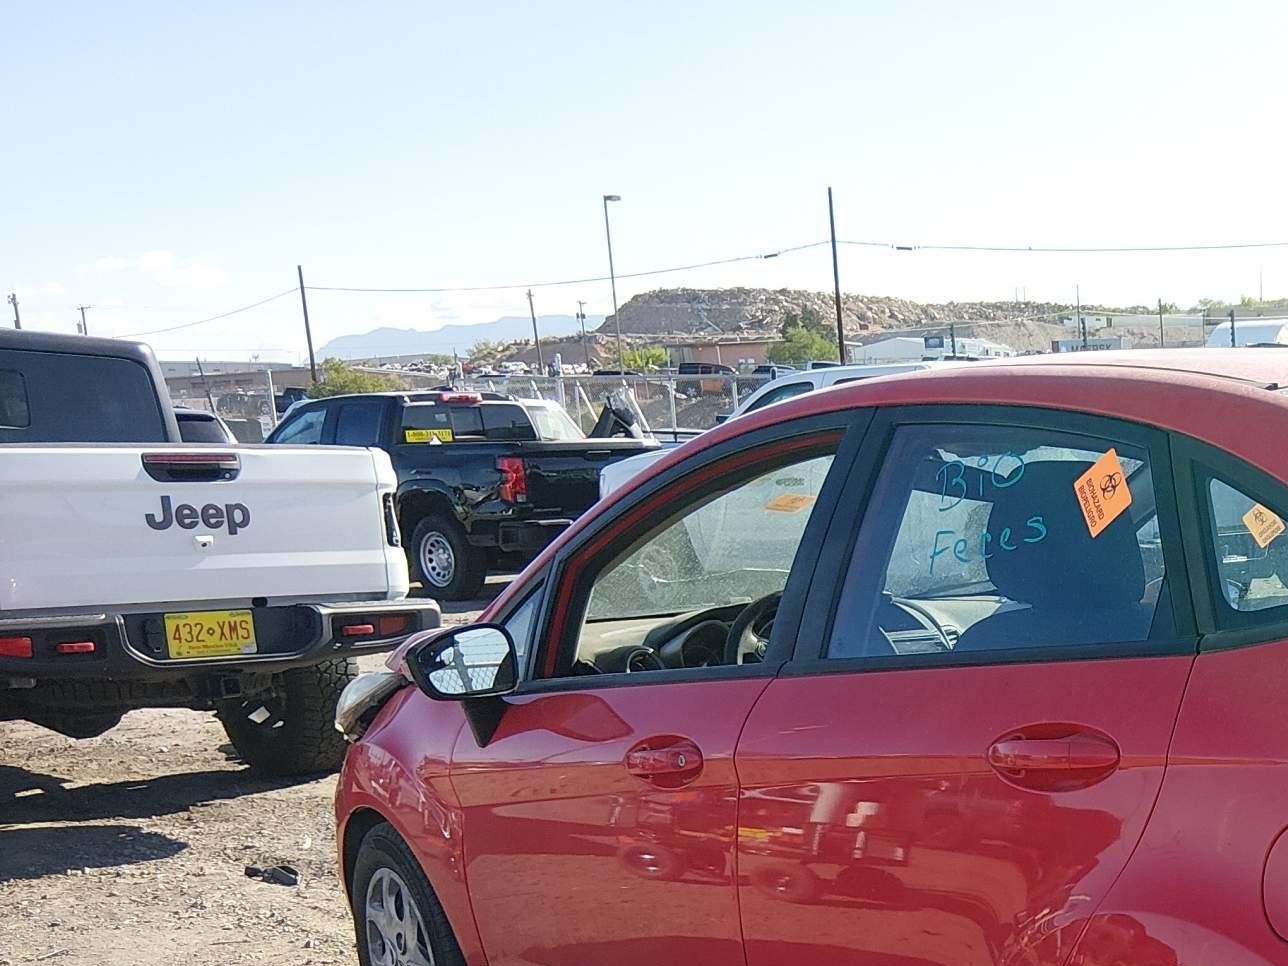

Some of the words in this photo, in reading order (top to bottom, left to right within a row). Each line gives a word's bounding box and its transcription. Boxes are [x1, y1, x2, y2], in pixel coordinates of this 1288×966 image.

[144, 495, 251, 536] Jeep
[1078, 485, 1097, 528] BIOPELIGRO
[1086, 477, 1105, 521] BIOHAZARD
[929, 516, 1048, 575] Feces
